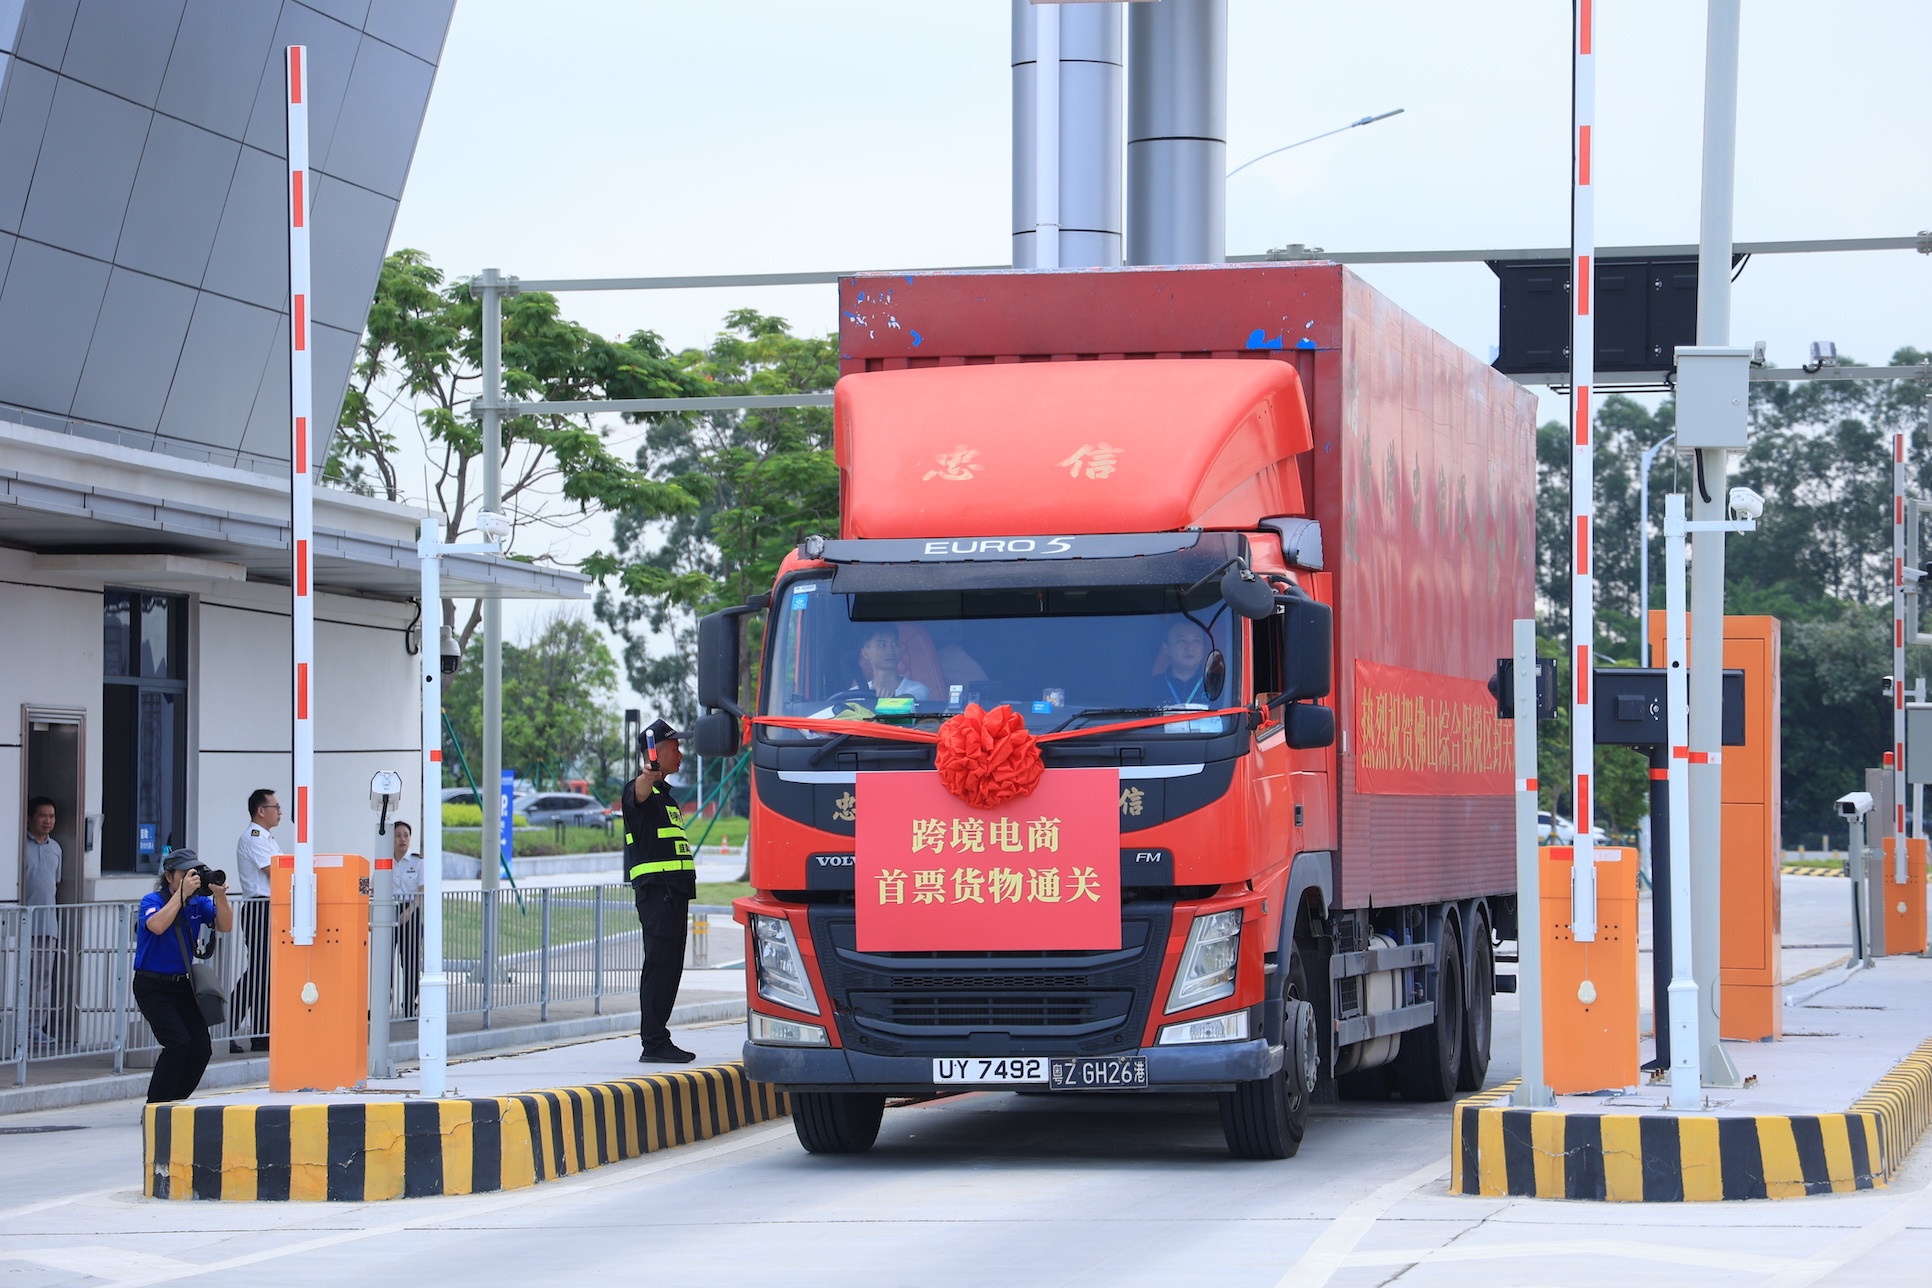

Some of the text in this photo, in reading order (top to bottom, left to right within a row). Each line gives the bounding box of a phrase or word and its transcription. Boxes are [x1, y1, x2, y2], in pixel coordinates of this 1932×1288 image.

[1055, 442, 1126, 479] 信
[924, 537, 1075, 555] EURO 5
[1361, 687, 1514, 774] 热烈祝贺佛山综合保税区封关
[1119, 786, 1145, 816] 信
[911, 816, 1062, 854] 跨境电商
[815, 856, 856, 867] VOL
[1135, 852, 1161, 863] FM
[873, 866, 1101, 905] 首票货物通关
[939, 1060, 1041, 1079] UY 7492
